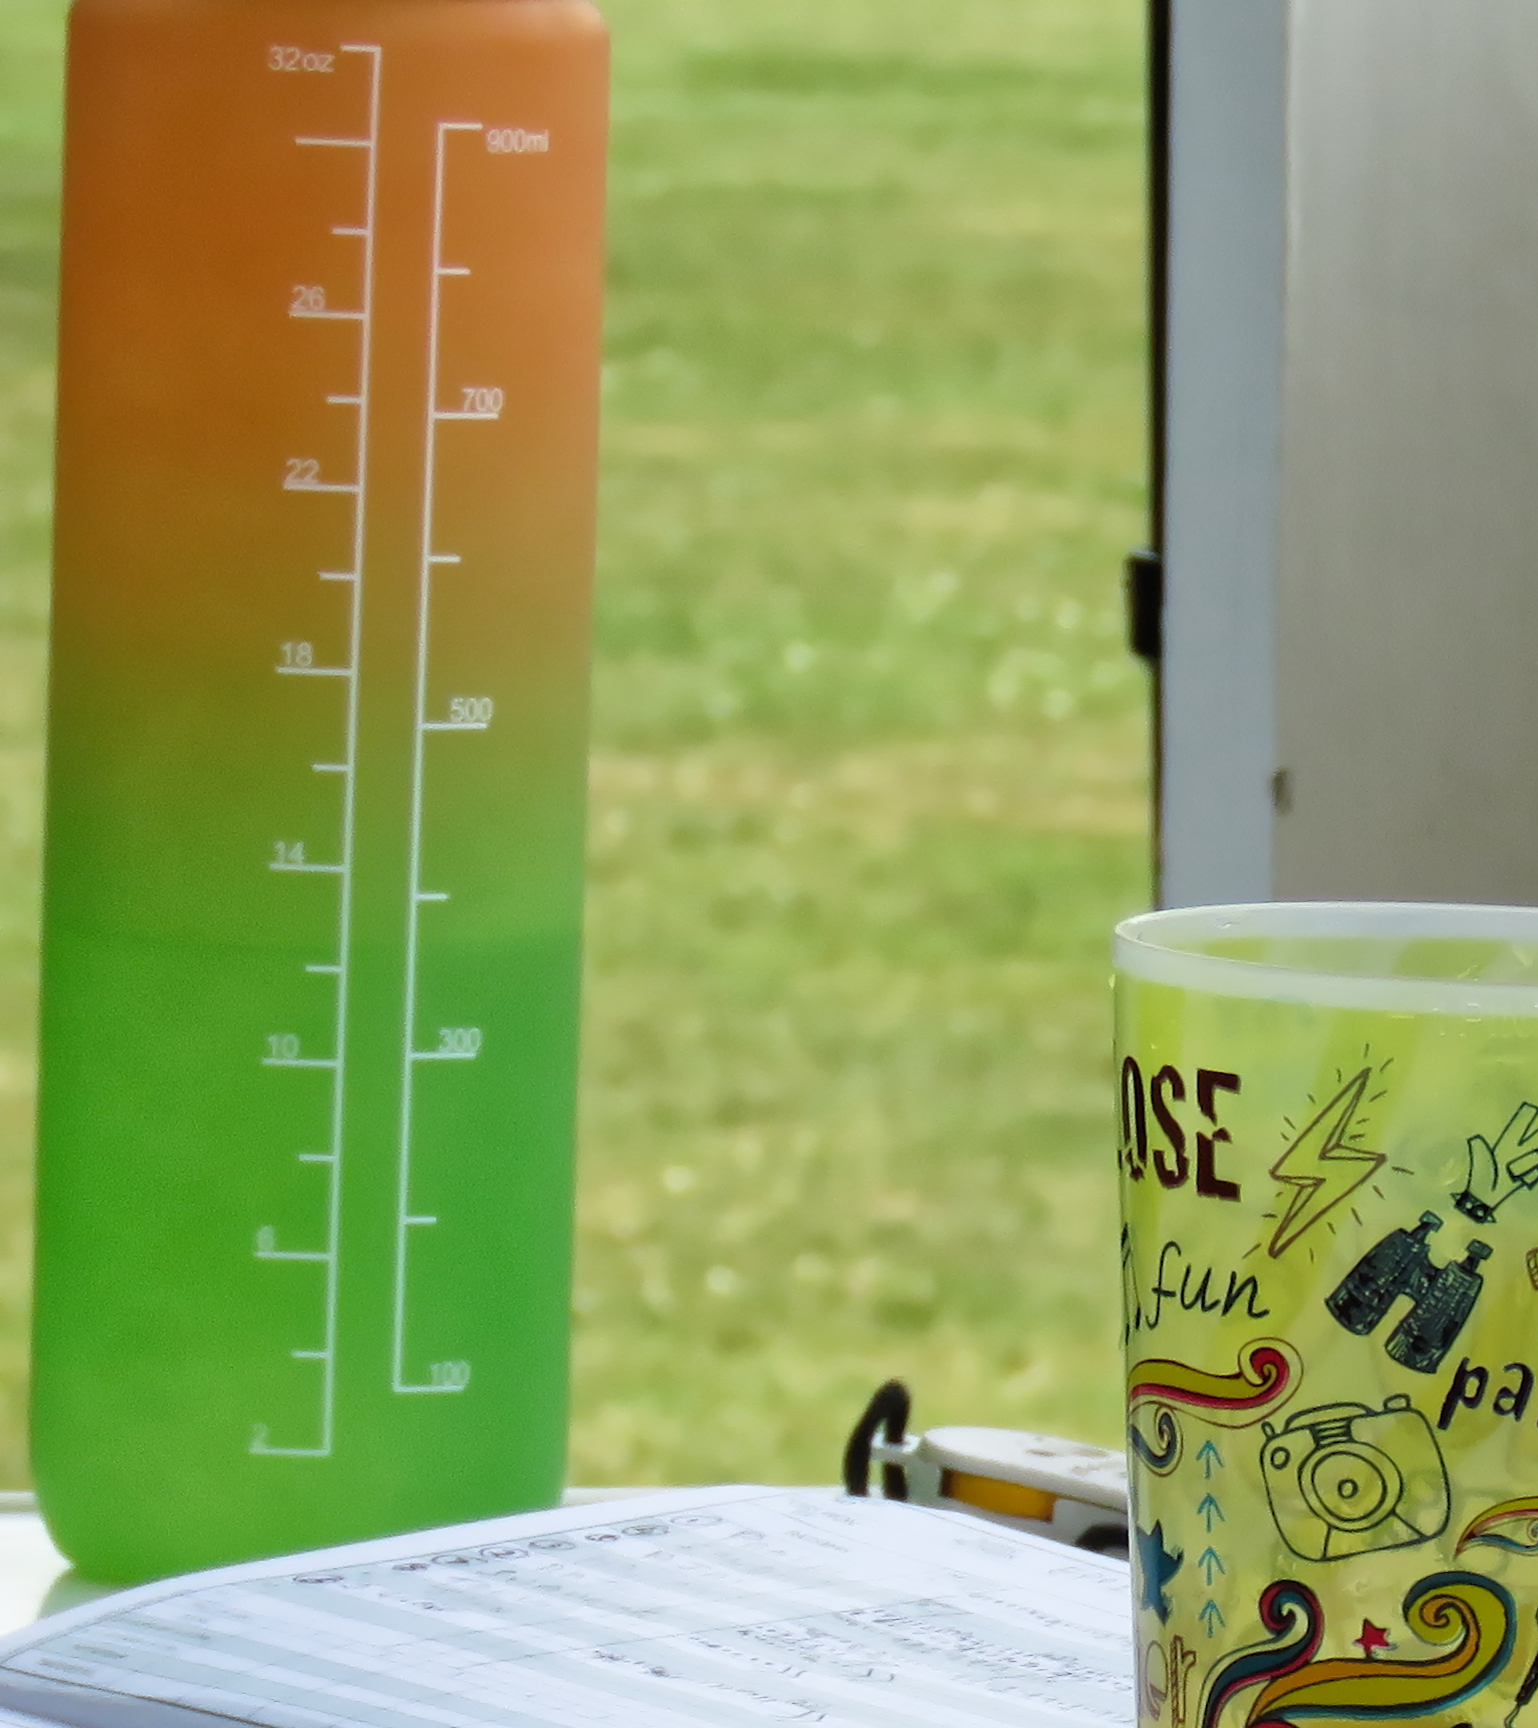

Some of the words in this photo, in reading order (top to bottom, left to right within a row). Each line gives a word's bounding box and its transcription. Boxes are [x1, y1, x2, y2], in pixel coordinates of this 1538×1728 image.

[485, 127, 550, 155] 900ml
[291, 285, 326, 312] 26
[462, 387, 505, 413] 700
[283, 458, 320, 484] 22
[281, 642, 313, 668] 18
[450, 698, 493, 724] 500
[274, 840, 306, 866] 14
[266, 1033, 300, 1060] 10
[438, 1027, 481, 1055] 300
[1117, 1056, 1242, 1202] OSE
[1145, 1241, 1270, 1330] fun
[430, 1360, 472, 1388] 100
[251, 1423, 269, 1450] 2
